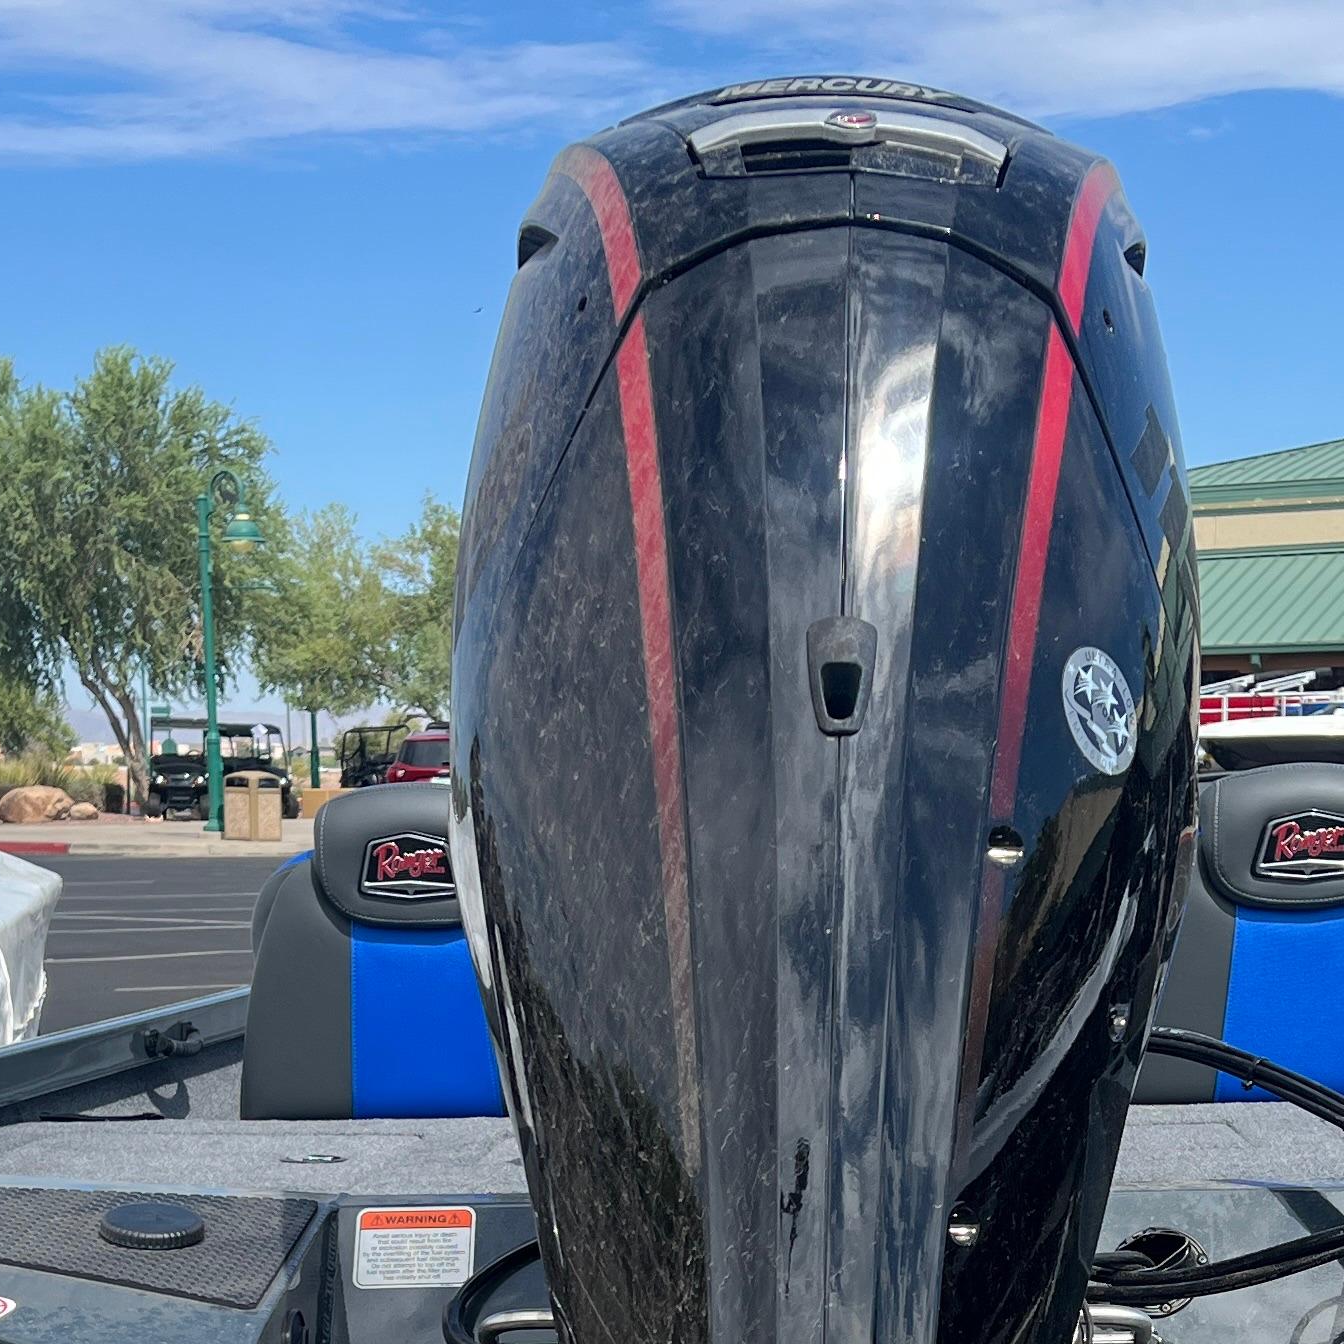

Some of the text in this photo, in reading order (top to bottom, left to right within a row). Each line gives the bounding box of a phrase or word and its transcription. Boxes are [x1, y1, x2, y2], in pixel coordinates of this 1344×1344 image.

[718, 77, 952, 99] MERCURY
[373, 842, 445, 880] Ranger
[385, 1215, 447, 1224] WARNING
